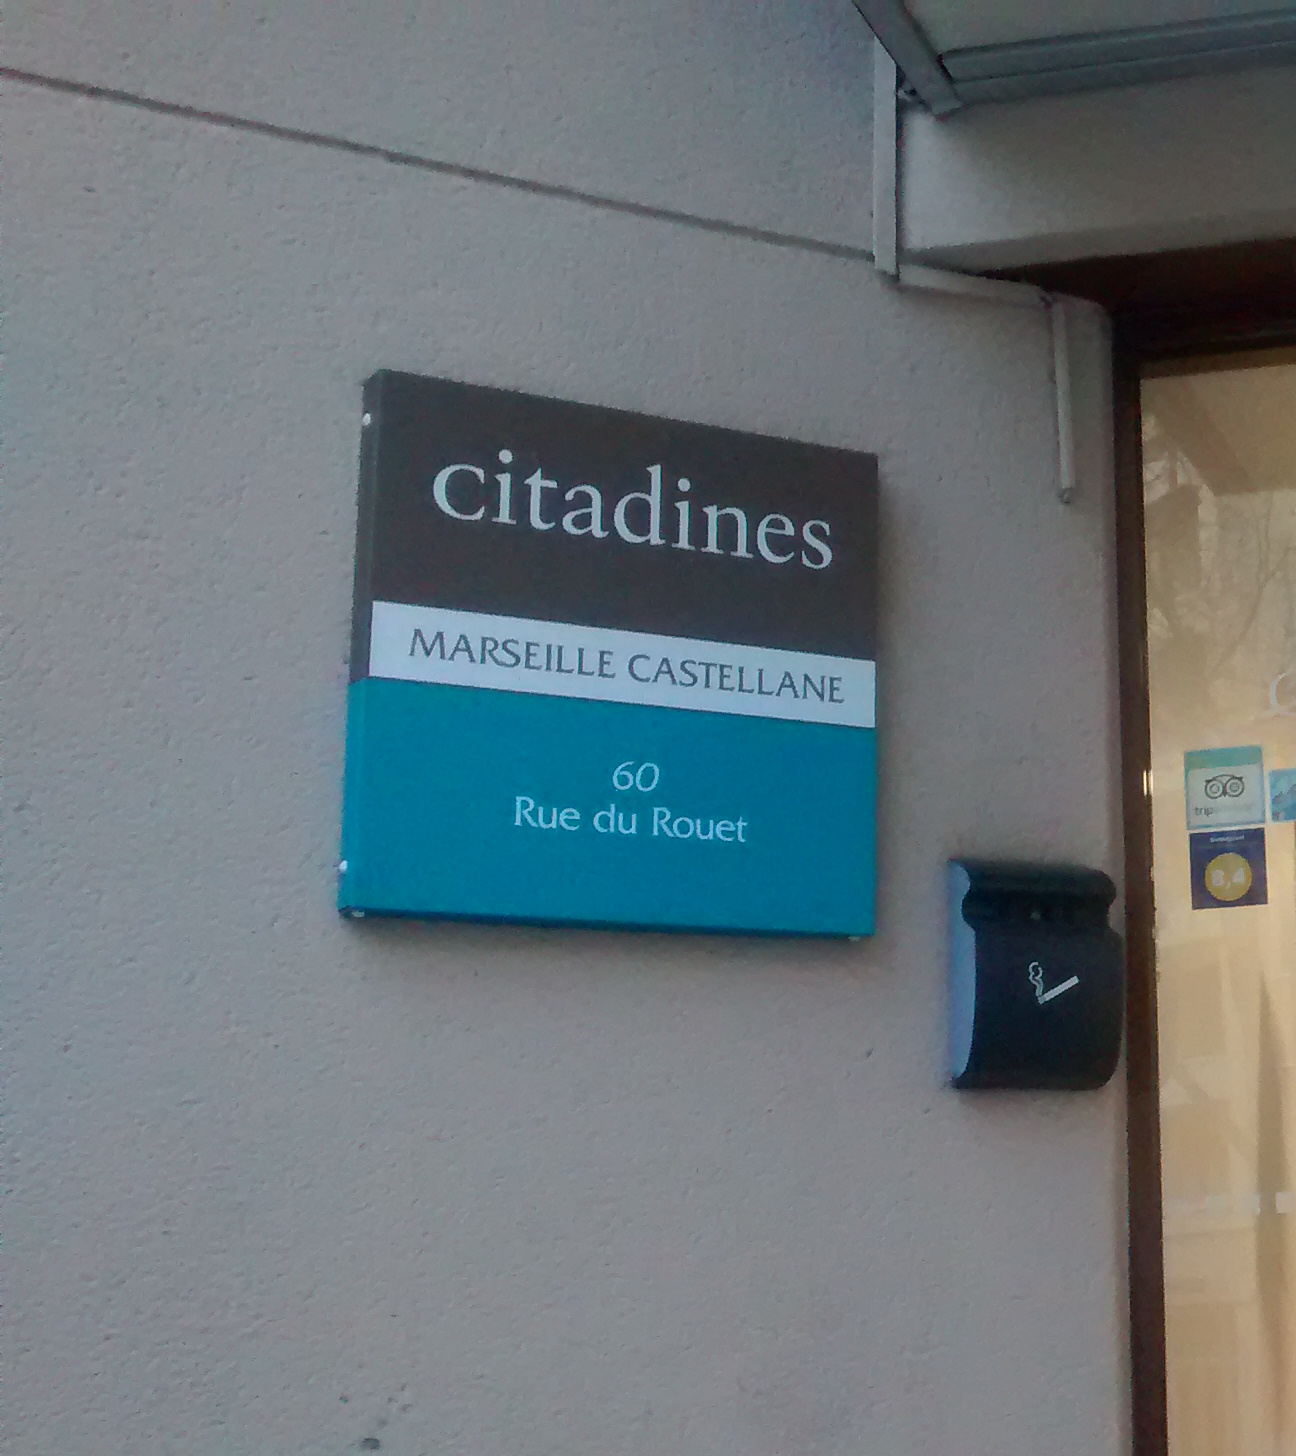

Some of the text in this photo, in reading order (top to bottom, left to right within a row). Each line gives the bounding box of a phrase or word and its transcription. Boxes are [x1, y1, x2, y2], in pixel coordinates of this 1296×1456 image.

[433, 449, 834, 571] citadines
[408, 628, 846, 704] MARSEILLE CASTELLANE
[611, 761, 661, 793] 60
[513, 796, 749, 845] Rue du Rouet
